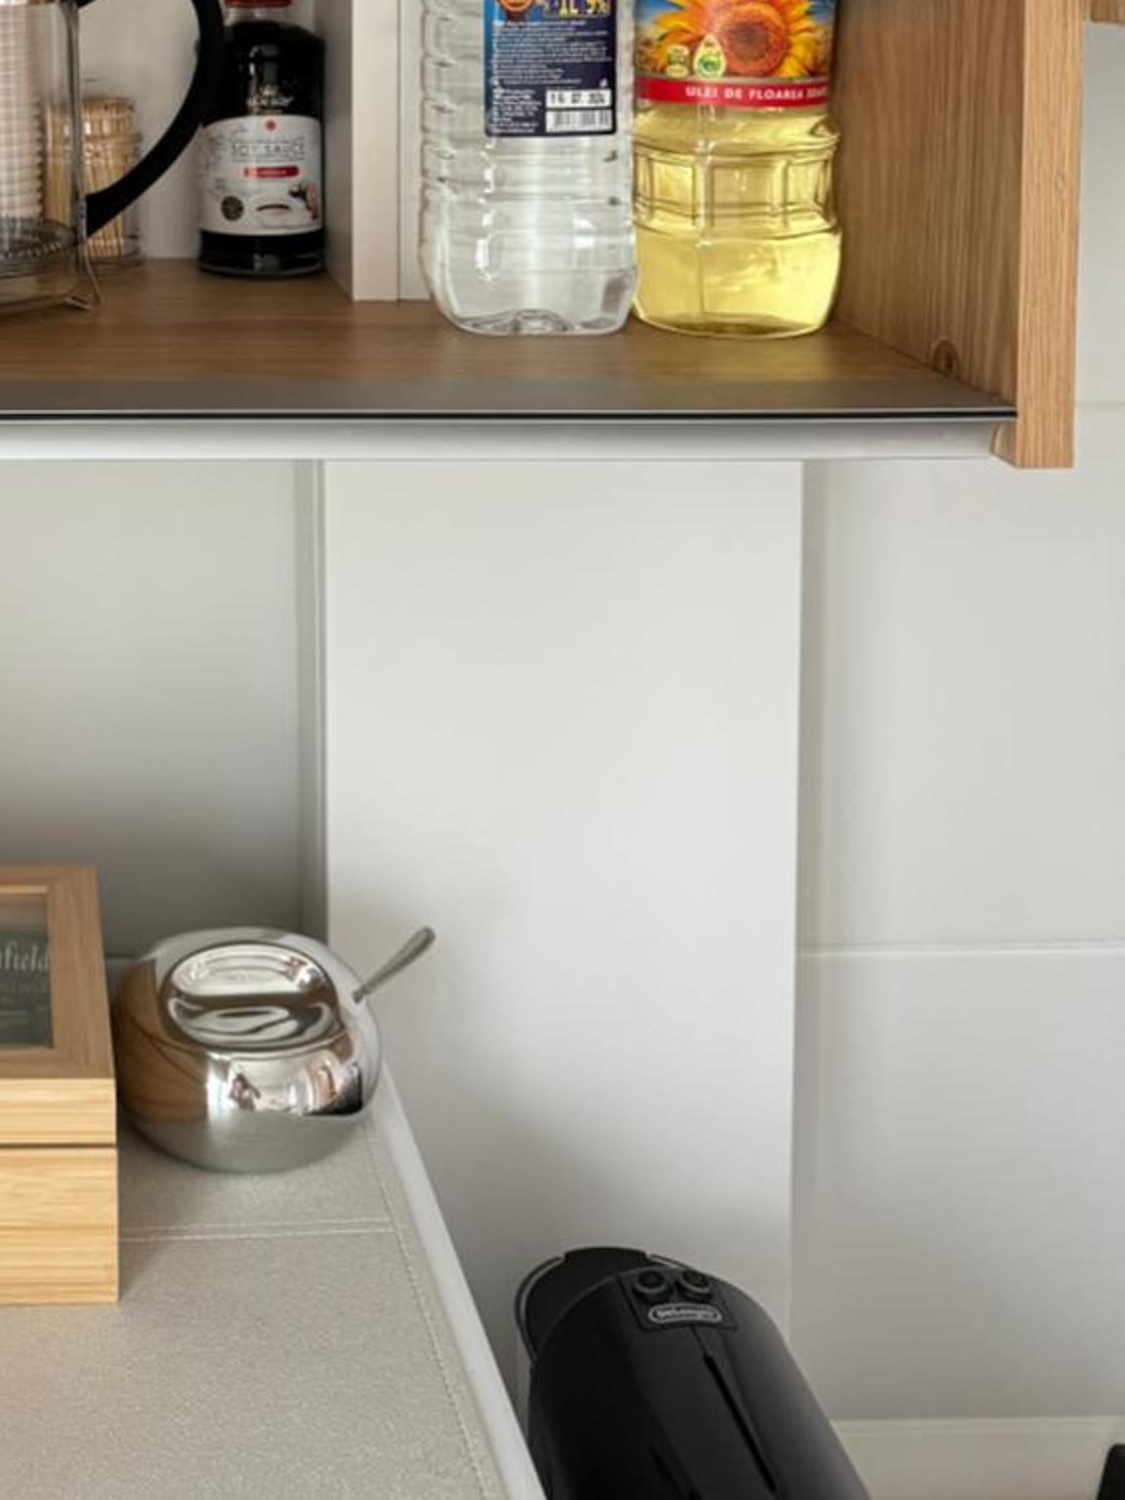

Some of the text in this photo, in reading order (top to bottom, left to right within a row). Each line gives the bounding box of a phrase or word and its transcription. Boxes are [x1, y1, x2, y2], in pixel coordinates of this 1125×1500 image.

[685, 86, 718, 99] ULEI
[725, 88, 744, 100] DE
[748, 88, 804, 101] FLOAREA
